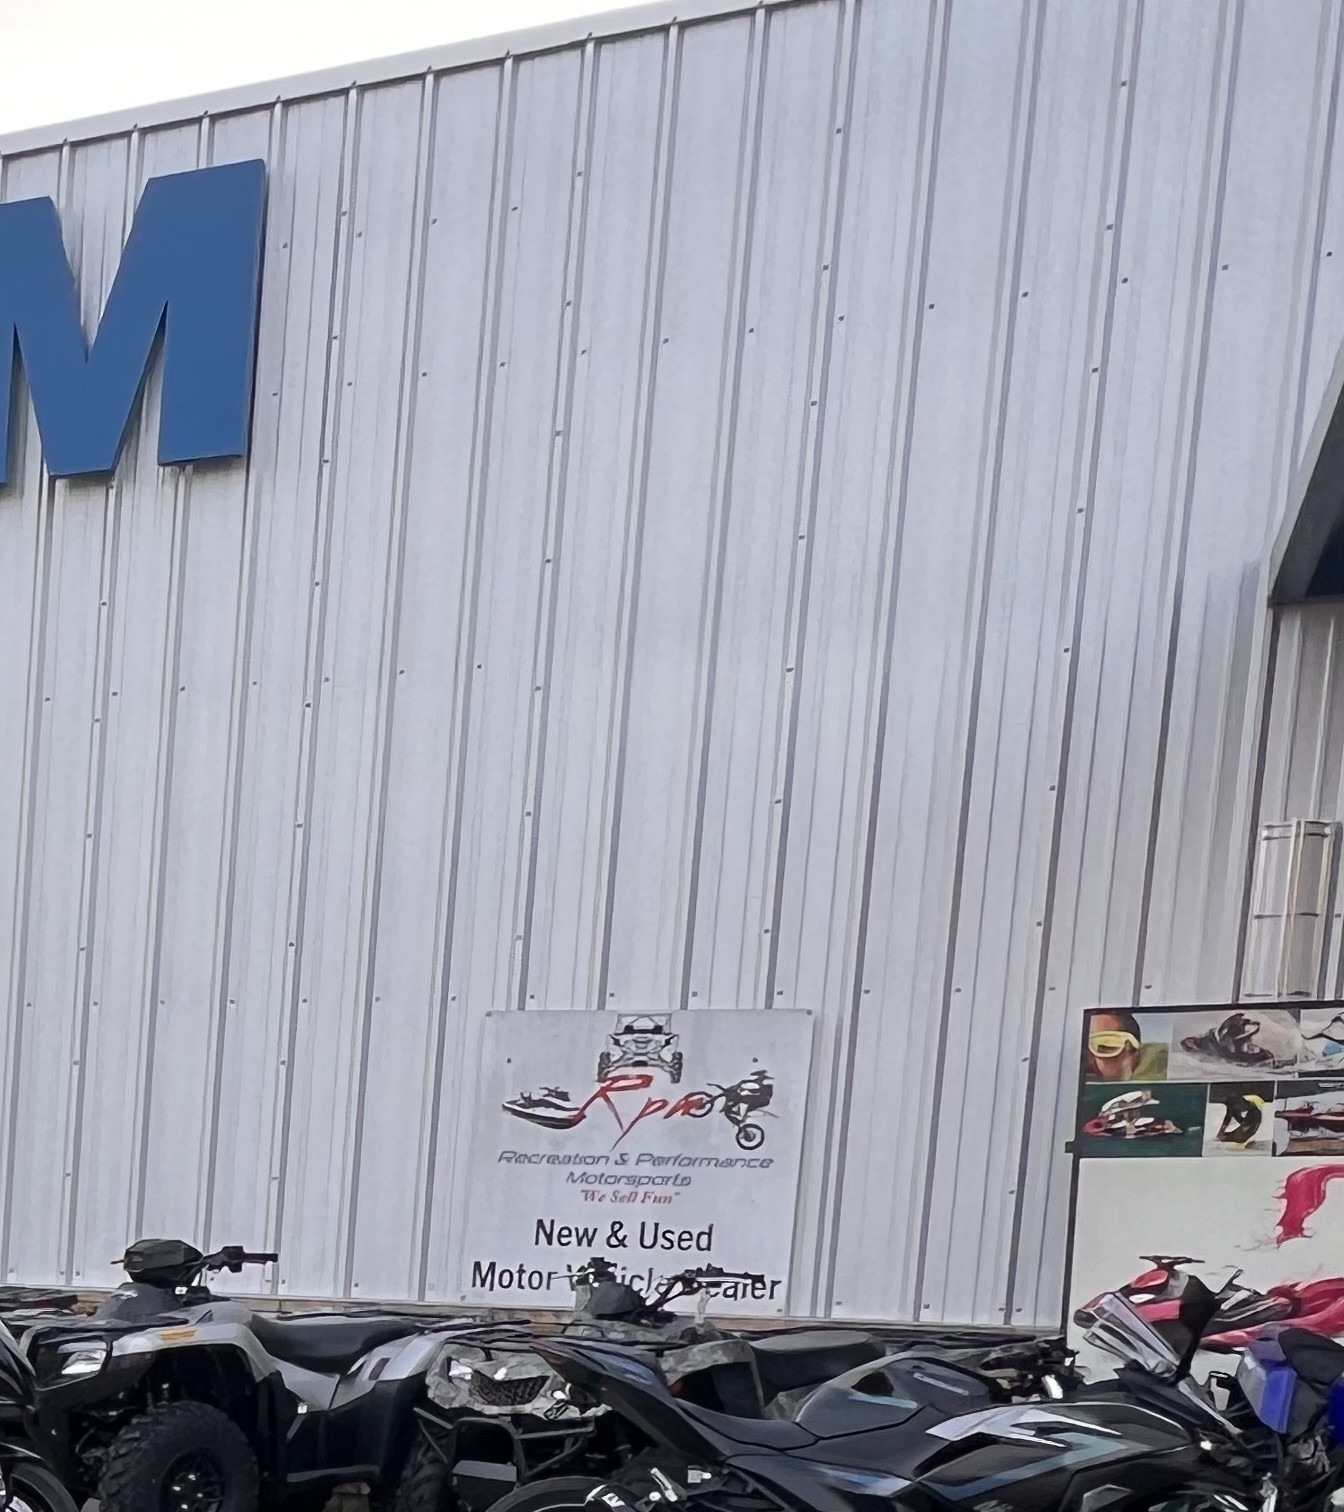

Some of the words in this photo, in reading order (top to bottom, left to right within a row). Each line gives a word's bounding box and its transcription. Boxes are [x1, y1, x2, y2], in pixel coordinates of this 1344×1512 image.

[497, 1150, 610, 1166] Recreation
[614, 1152, 630, 1166] &
[635, 1152, 775, 1169] Performance
[566, 1171, 692, 1188] Motorsports
[534, 1218, 598, 1248] New
[606, 1220, 628, 1249] &
[639, 1222, 714, 1252] Used
[471, 1261, 558, 1292] Motor
